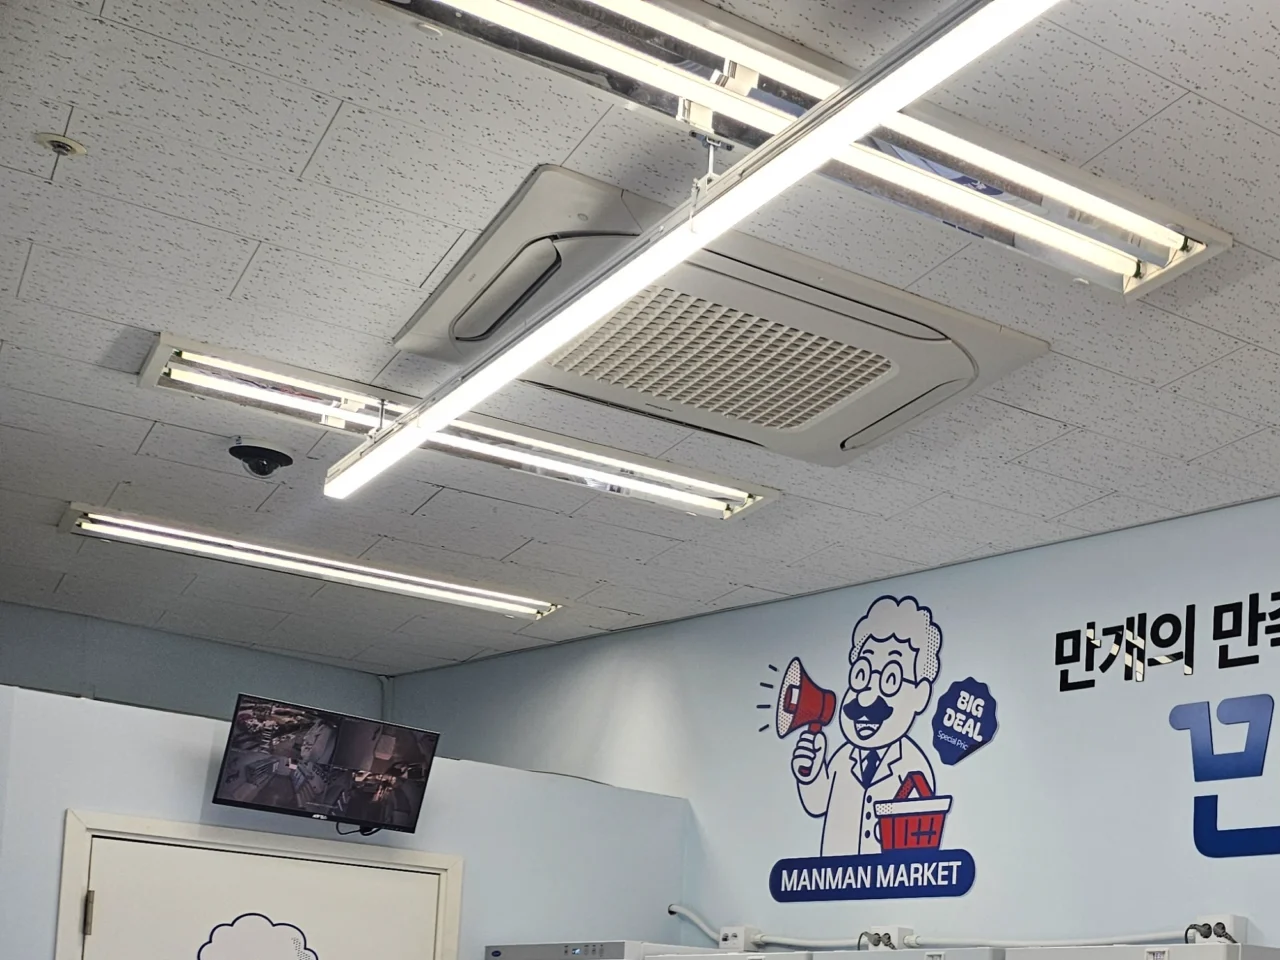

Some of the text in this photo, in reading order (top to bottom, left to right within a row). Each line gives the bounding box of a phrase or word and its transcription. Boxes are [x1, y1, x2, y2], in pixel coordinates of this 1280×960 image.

[1055, 604, 1196, 692] 만개의
[956, 690, 985, 718] BIG
[937, 730, 958, 746] Special
[943, 707, 983, 742] DEAL
[780, 861, 962, 892] MANMAN MARKET
